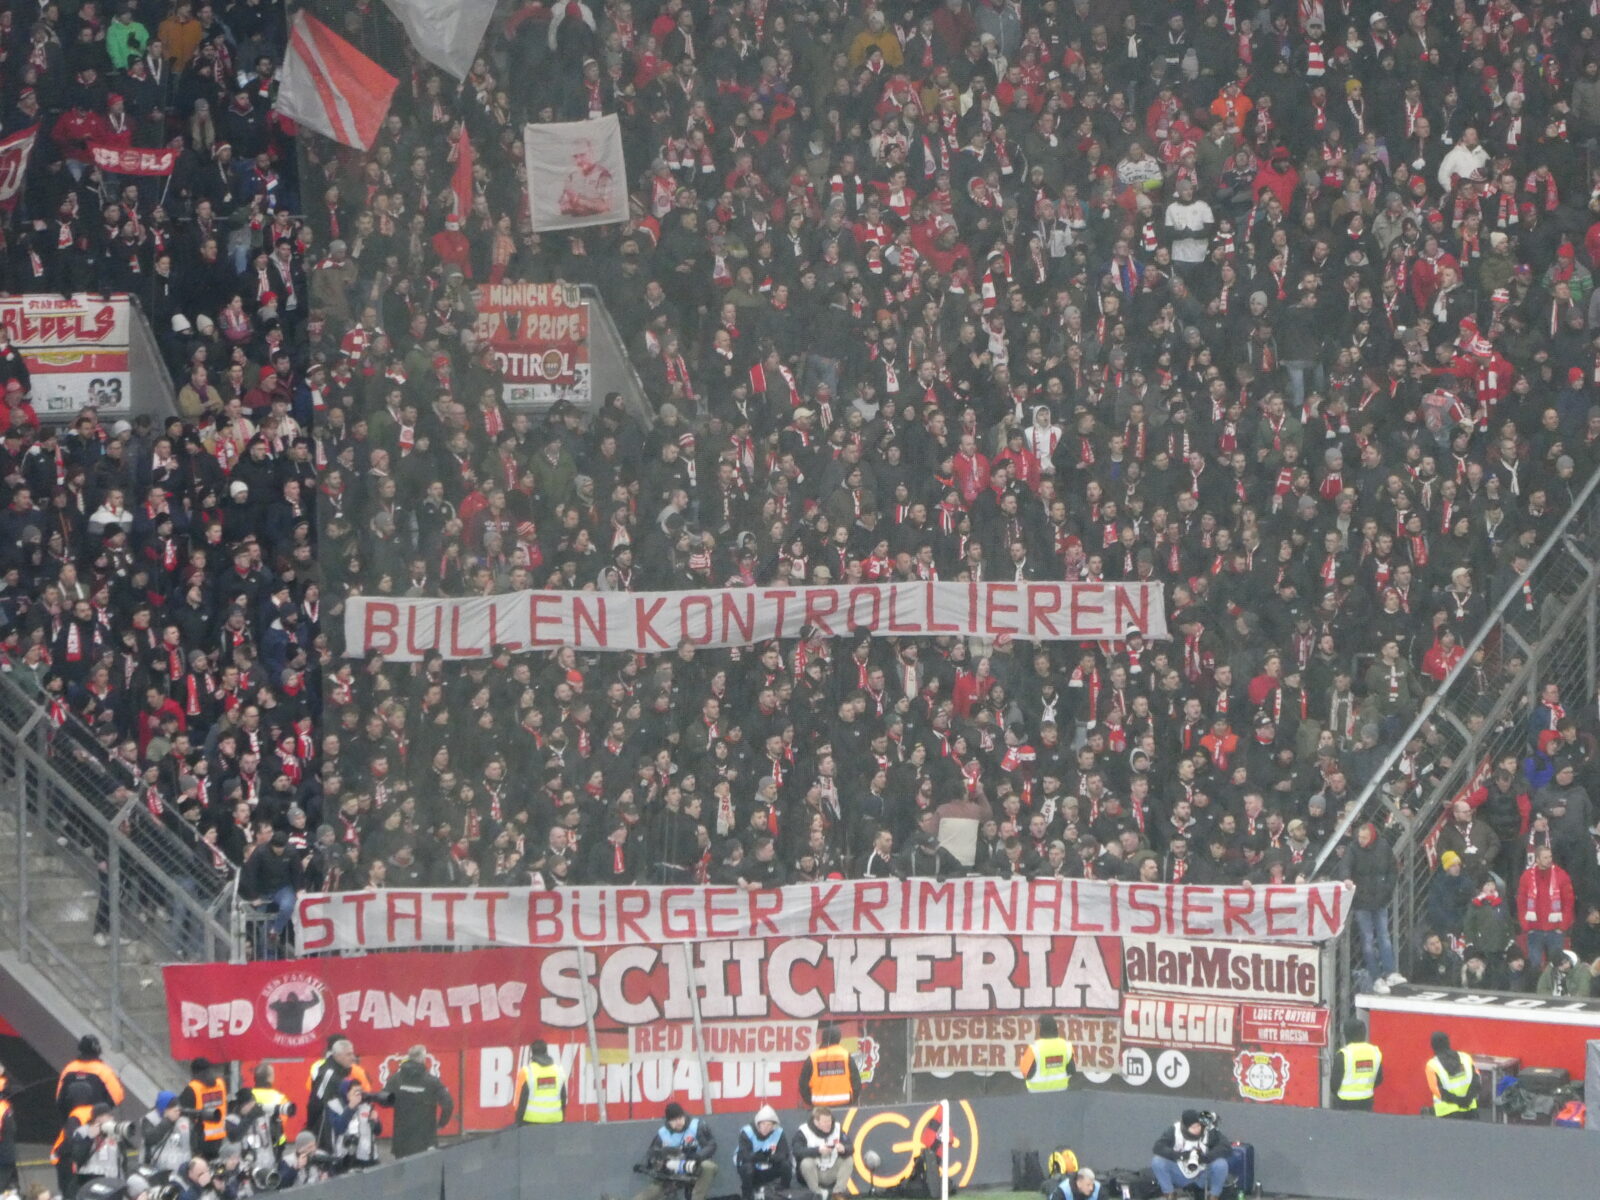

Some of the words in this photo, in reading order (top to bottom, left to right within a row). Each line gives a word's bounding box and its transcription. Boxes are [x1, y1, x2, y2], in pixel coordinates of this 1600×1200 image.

[490, 284, 548, 307] MUNICH
[527, 313, 580, 340] PRIDE
[364, 594, 608, 656] BULLEN
[635, 582, 1149, 649] KONTROLLIEREN
[300, 891, 509, 949] STATT
[528, 887, 783, 944] BÜRGER
[808, 879, 1342, 937] KRIMINALISIEREN
[540, 936, 1120, 1027] SCHICKERIA
[1126, 942, 1317, 997] alarMstufe
[180, 999, 254, 1039] RED
[337, 981, 527, 1030] FANATIC
[1123, 998, 1235, 1045] COLEGIO
[635, 1026, 683, 1053] RED
[913, 1044, 1006, 1068] IMMER
[1128, 1059, 1143, 1075] in
